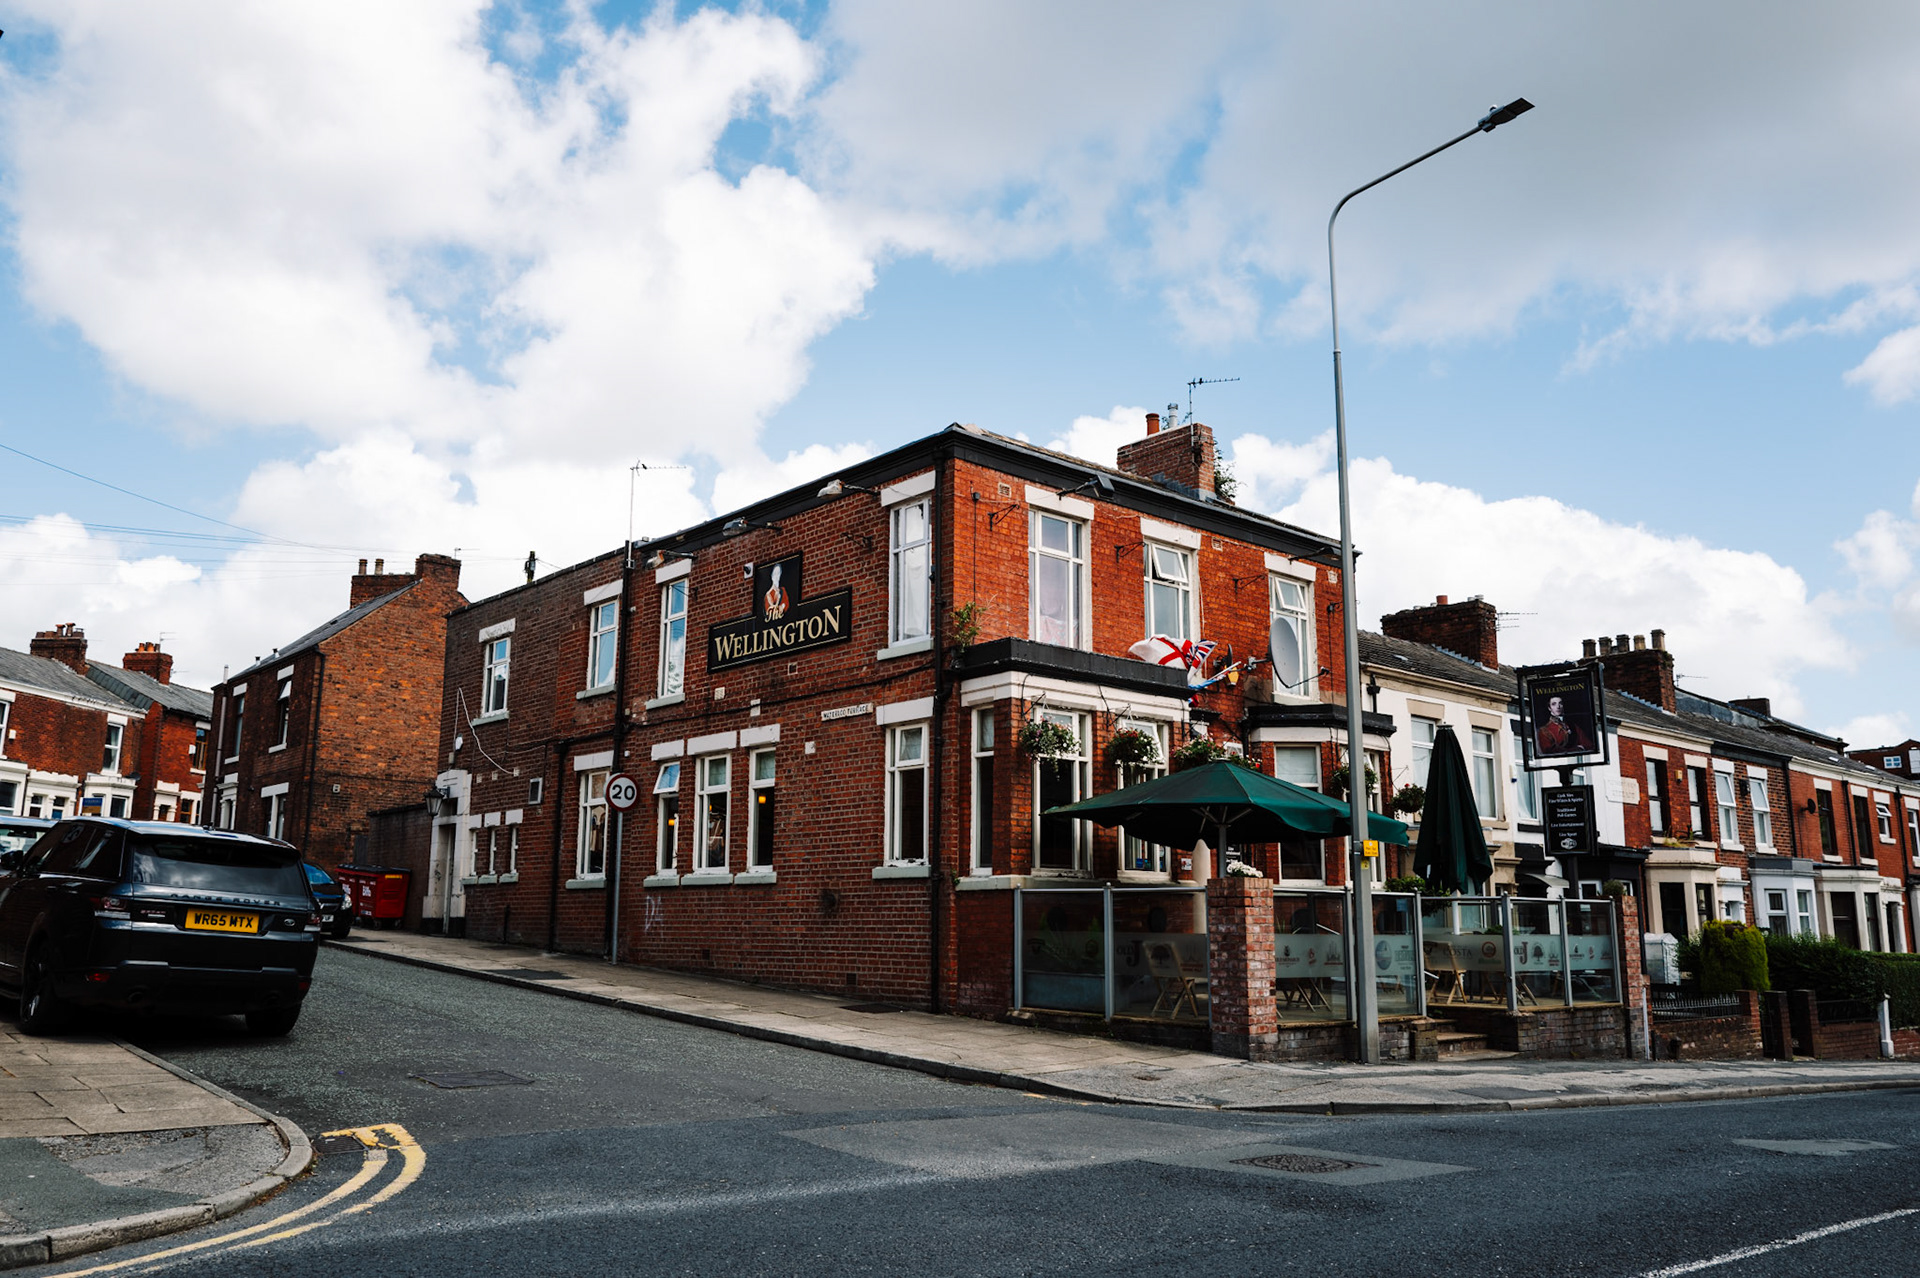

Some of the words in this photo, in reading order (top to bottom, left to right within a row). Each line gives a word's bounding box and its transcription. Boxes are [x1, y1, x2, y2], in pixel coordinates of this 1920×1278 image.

[765, 605, 784, 622] The
[715, 605, 842, 661] WELLINGTON
[1536, 683, 1585, 695] WELLINGTON
[612, 784, 636, 800] 20
[170, 893, 223, 902] RANGE
[232, 897, 281, 906] ROVER
[194, 912, 227, 926] WR65
[229, 915, 254, 928] MTX
